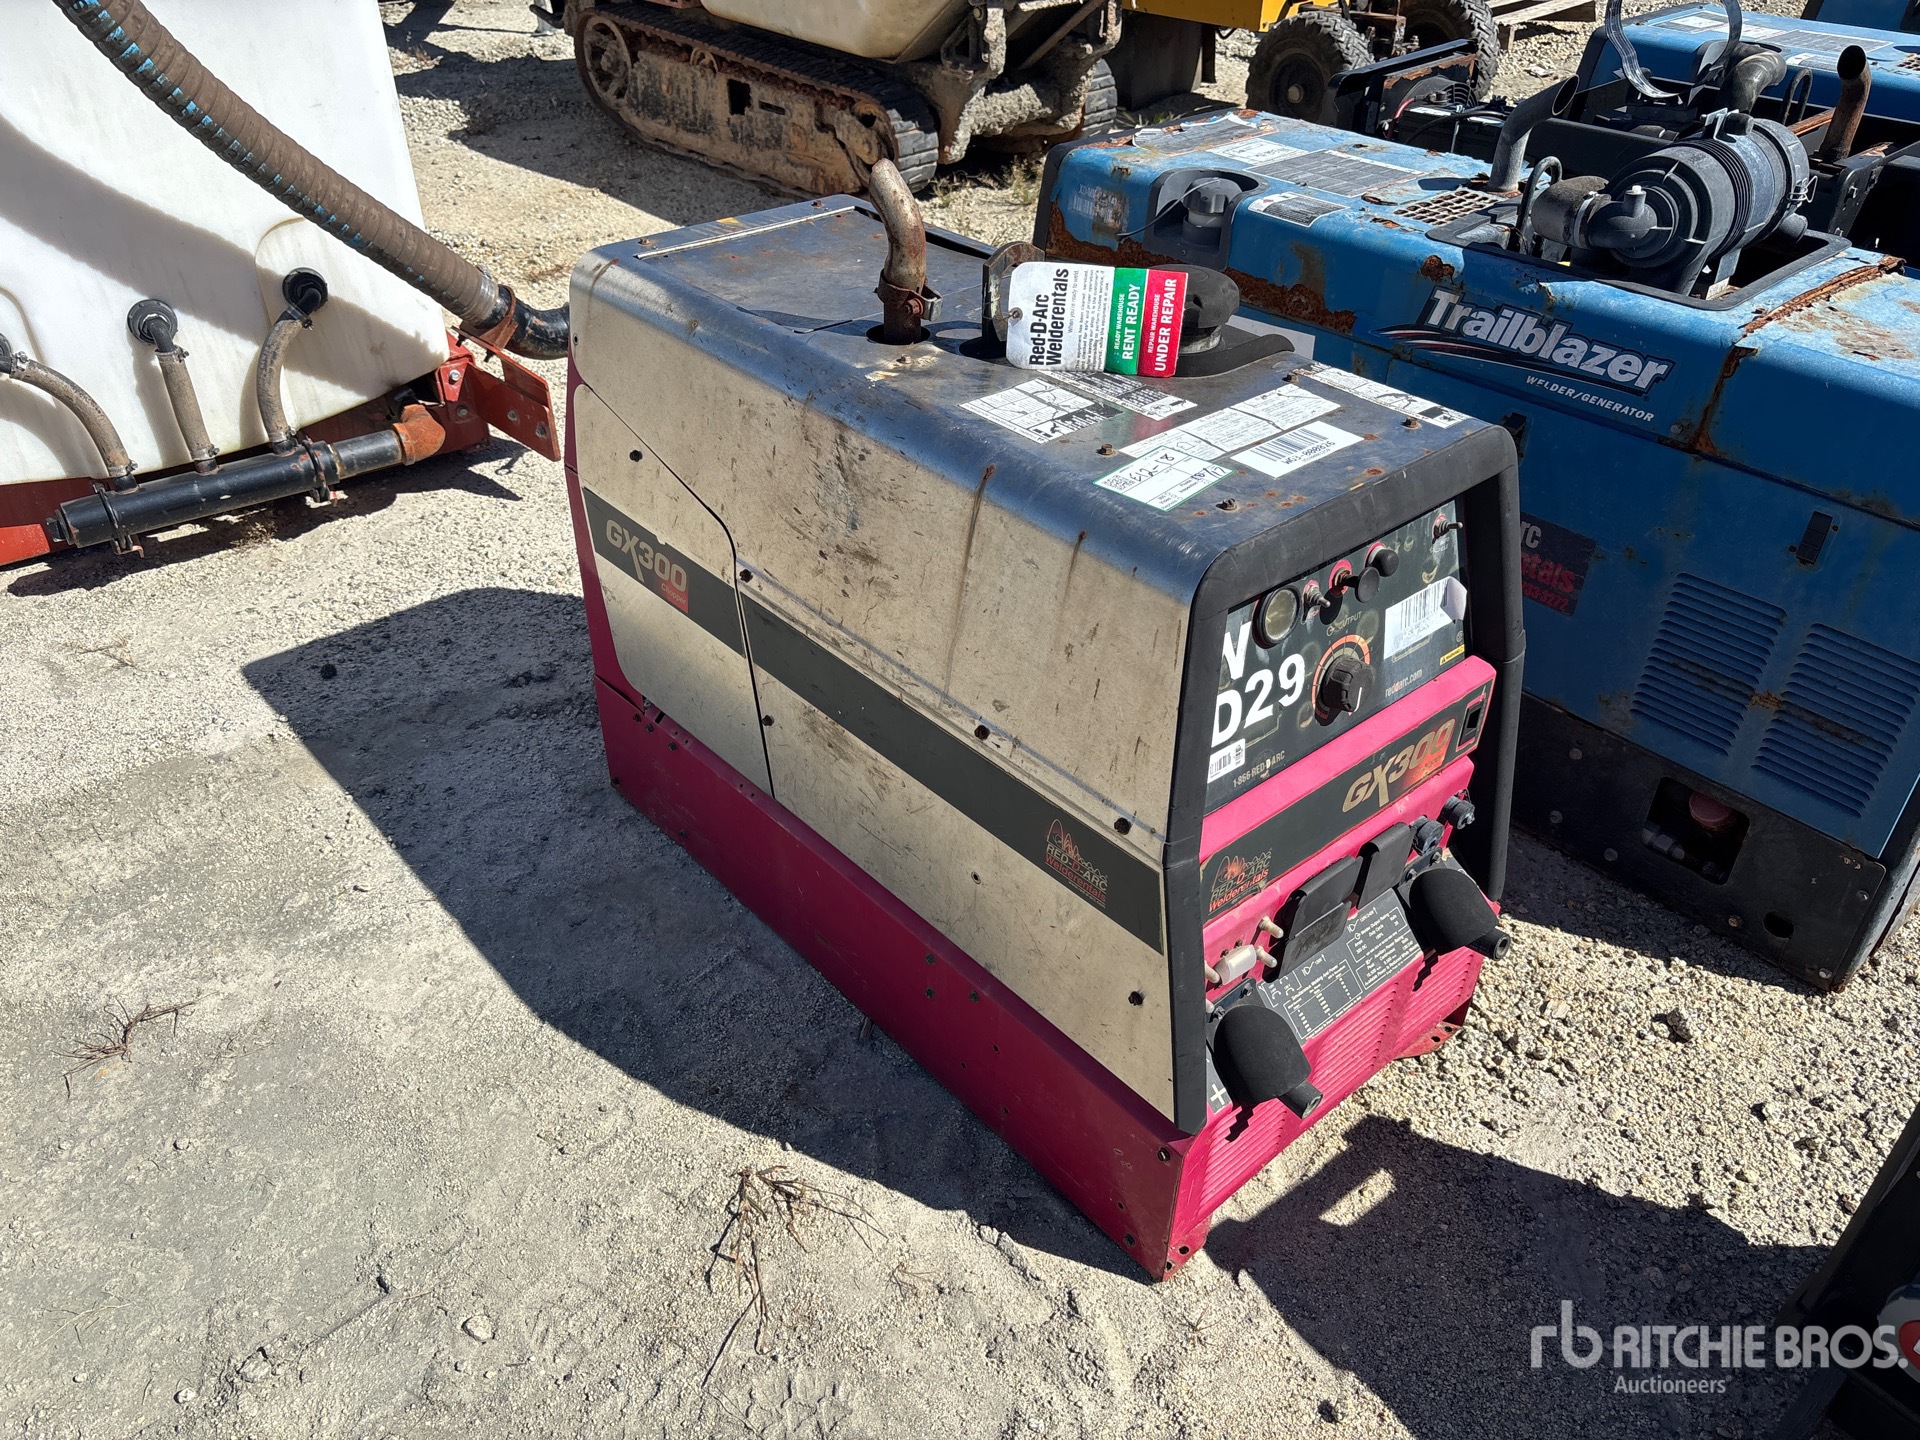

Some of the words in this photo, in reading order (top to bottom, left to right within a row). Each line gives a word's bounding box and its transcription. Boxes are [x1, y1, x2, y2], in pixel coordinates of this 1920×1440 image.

[1045, 268, 1069, 365] Welderentals
[1115, 293, 1125, 330] WAREHOUSE
[1126, 283, 1141, 325] READY
[1150, 293, 1160, 331] WAREHOUSE
[1160, 278, 1177, 324] REPAIR
[1113, 330, 1122, 350] READY
[1121, 327, 1136, 360] RENT
[1147, 331, 1156, 353] REPAIR
[1154, 327, 1171, 372] UNDER
[1427, 289, 1669, 390] Trailblazer
[1526, 375, 1655, 421] WELDER/GENERATOR
[606, 519, 687, 592] GX300
[661, 583, 686, 605] Chopper
[1211, 653, 1305, 749] D29
[1342, 718, 1456, 813] GX300
[1045, 853, 1106, 902] Welderentals
[1046, 843, 1108, 892] RED-D-ARC
